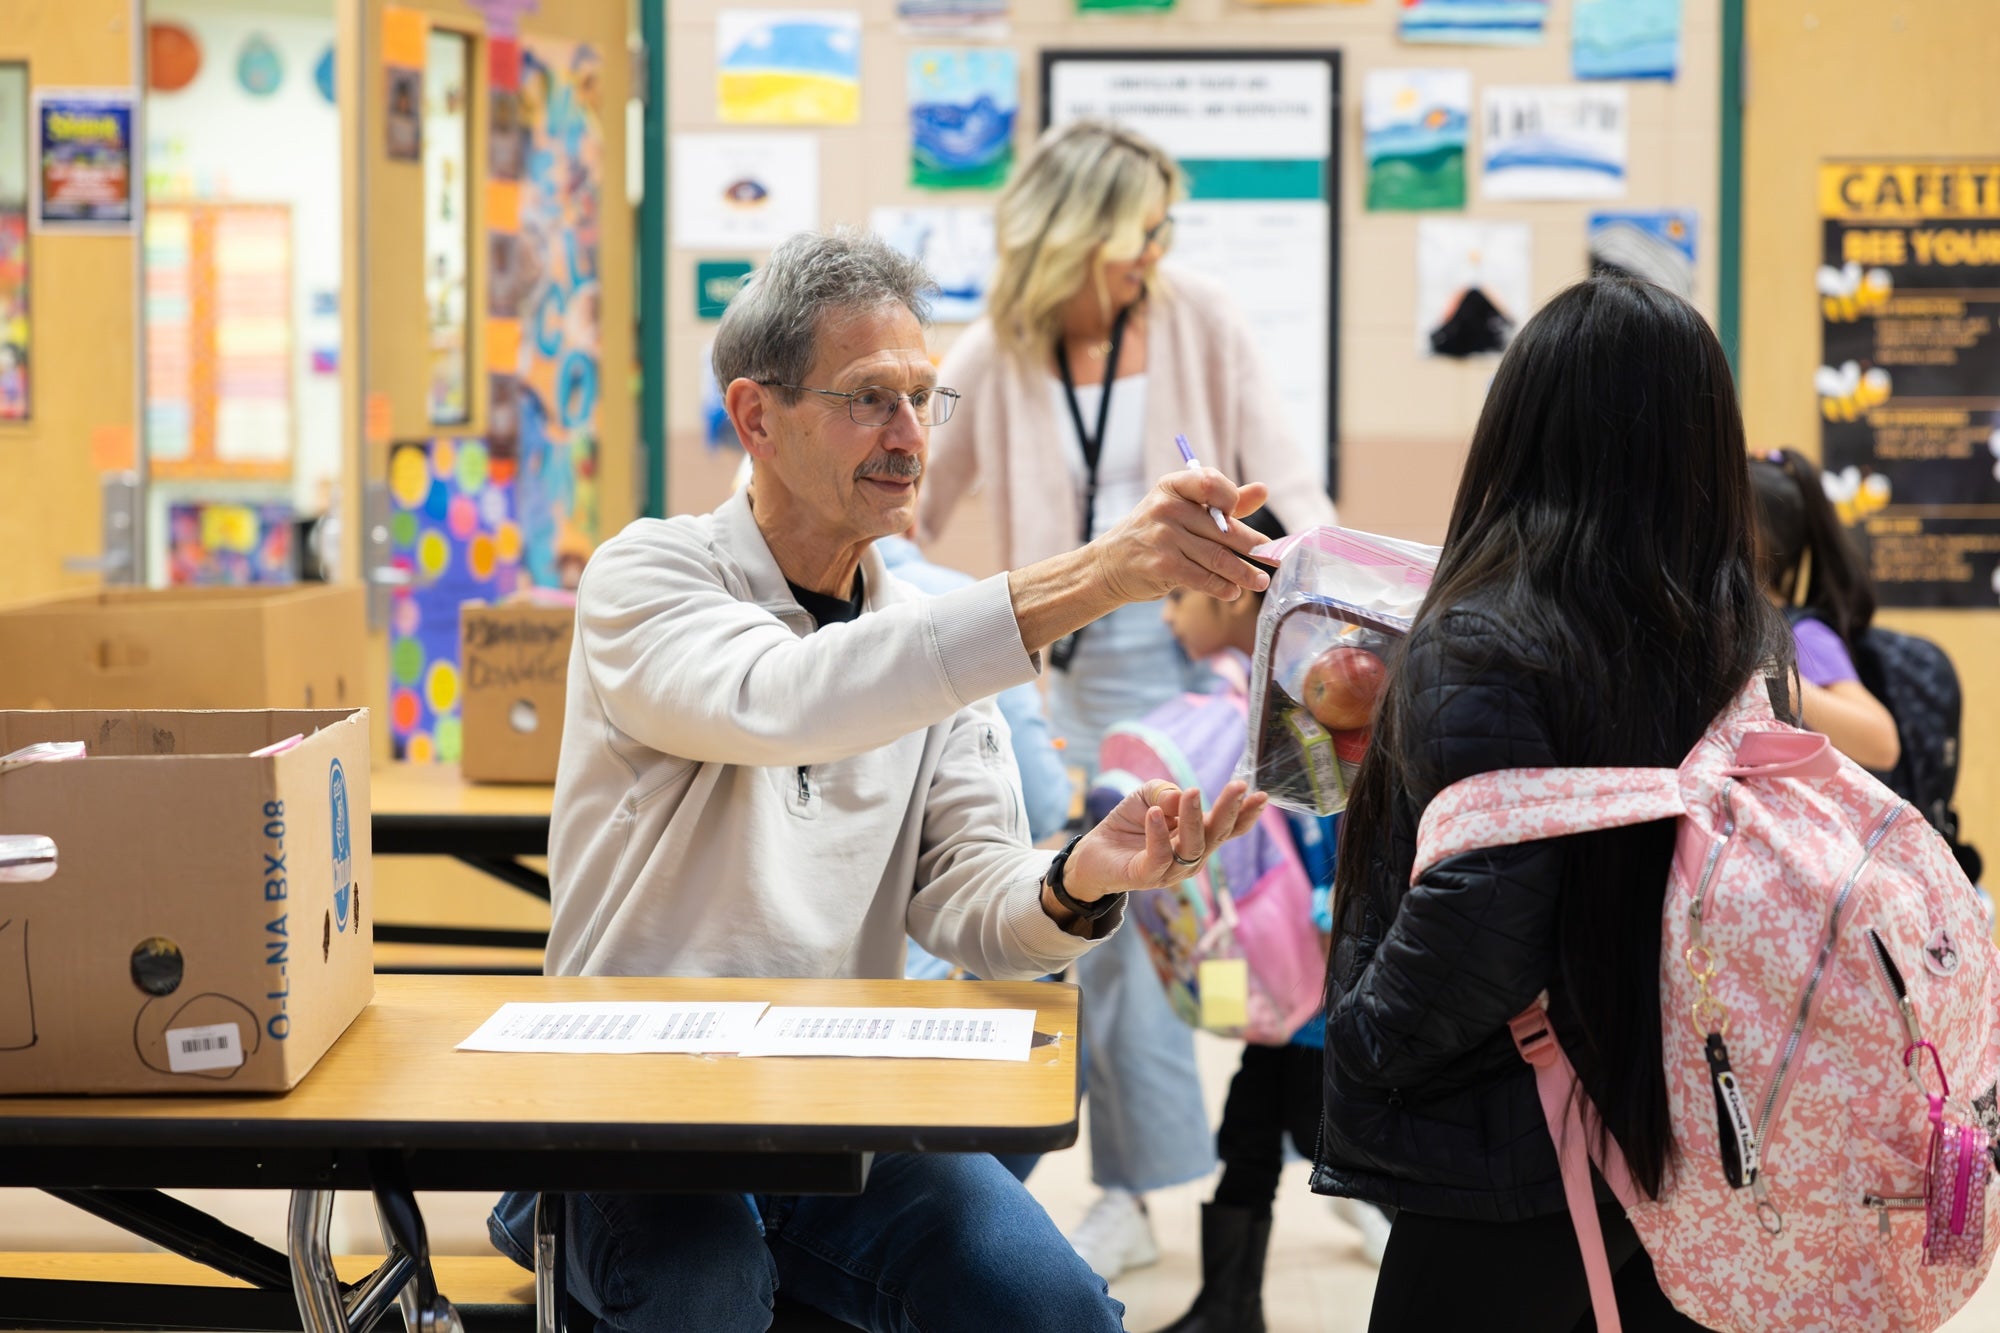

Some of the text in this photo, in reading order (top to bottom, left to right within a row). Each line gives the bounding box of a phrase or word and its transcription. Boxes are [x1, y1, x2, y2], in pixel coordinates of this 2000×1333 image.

[1840, 173, 2000, 209] CAFET
[1842, 229, 1907, 266] BEE
[263, 799, 290, 1041] O-L-NA BX-08
[1729, 1091, 1746, 1130] Good
